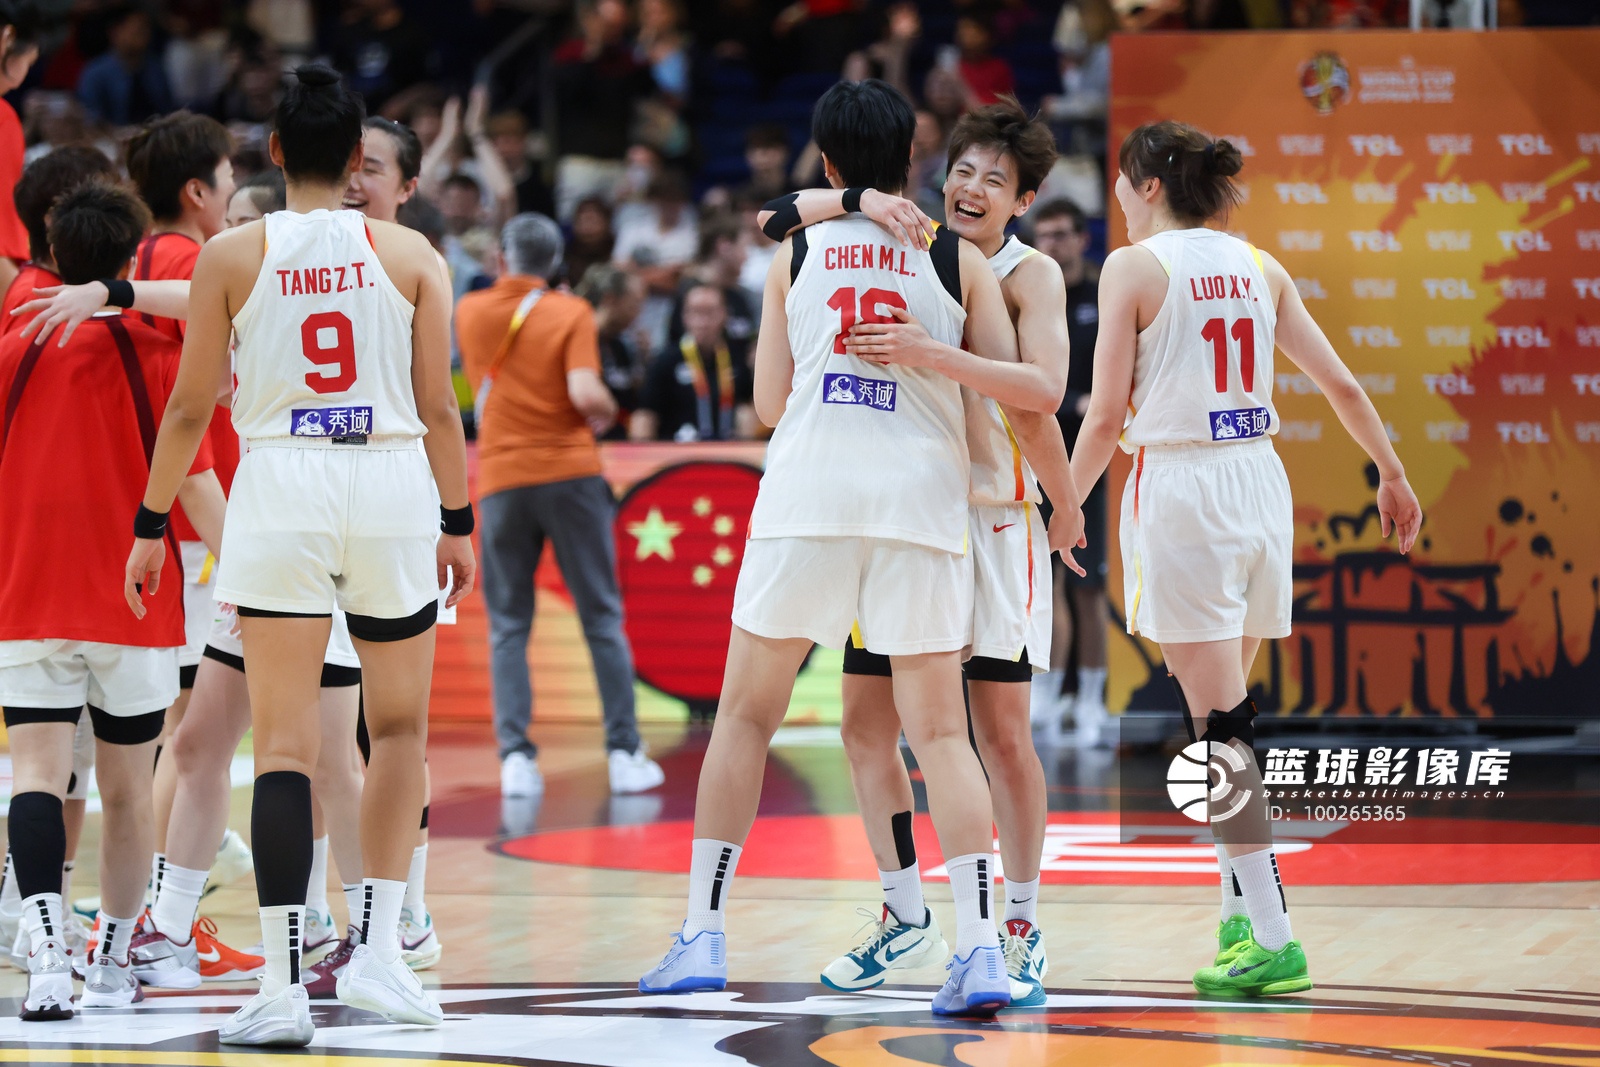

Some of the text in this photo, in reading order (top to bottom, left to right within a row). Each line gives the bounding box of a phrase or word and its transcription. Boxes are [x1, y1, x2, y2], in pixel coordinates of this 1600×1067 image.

[1350, 135, 1402, 156] TCL
[1498, 134, 1552, 155] TCL
[1275, 183, 1328, 204] TCL
[1423, 182, 1476, 203] TCL
[1349, 231, 1402, 251] TCL
[1498, 230, 1551, 251] TCL
[825, 243, 917, 277] CHEN M.L.
[276, 262, 375, 296] TANG Z.T.
[1189, 275, 1258, 302] LUO X.Y.
[1295, 278, 1327, 298] CL
[1423, 278, 1475, 299] TCL
[1348, 326, 1401, 347] TCL
[1498, 326, 1550, 347] TCL
[301, 311, 357, 394] 9
[1201, 317, 1254, 393] 11
[859, 379, 894, 409] 秀域
[1423, 374, 1475, 395] TCL
[328, 409, 370, 435] 秀域
[1235, 409, 1268, 437] 秀域
[1497, 422, 1549, 443] TCL
